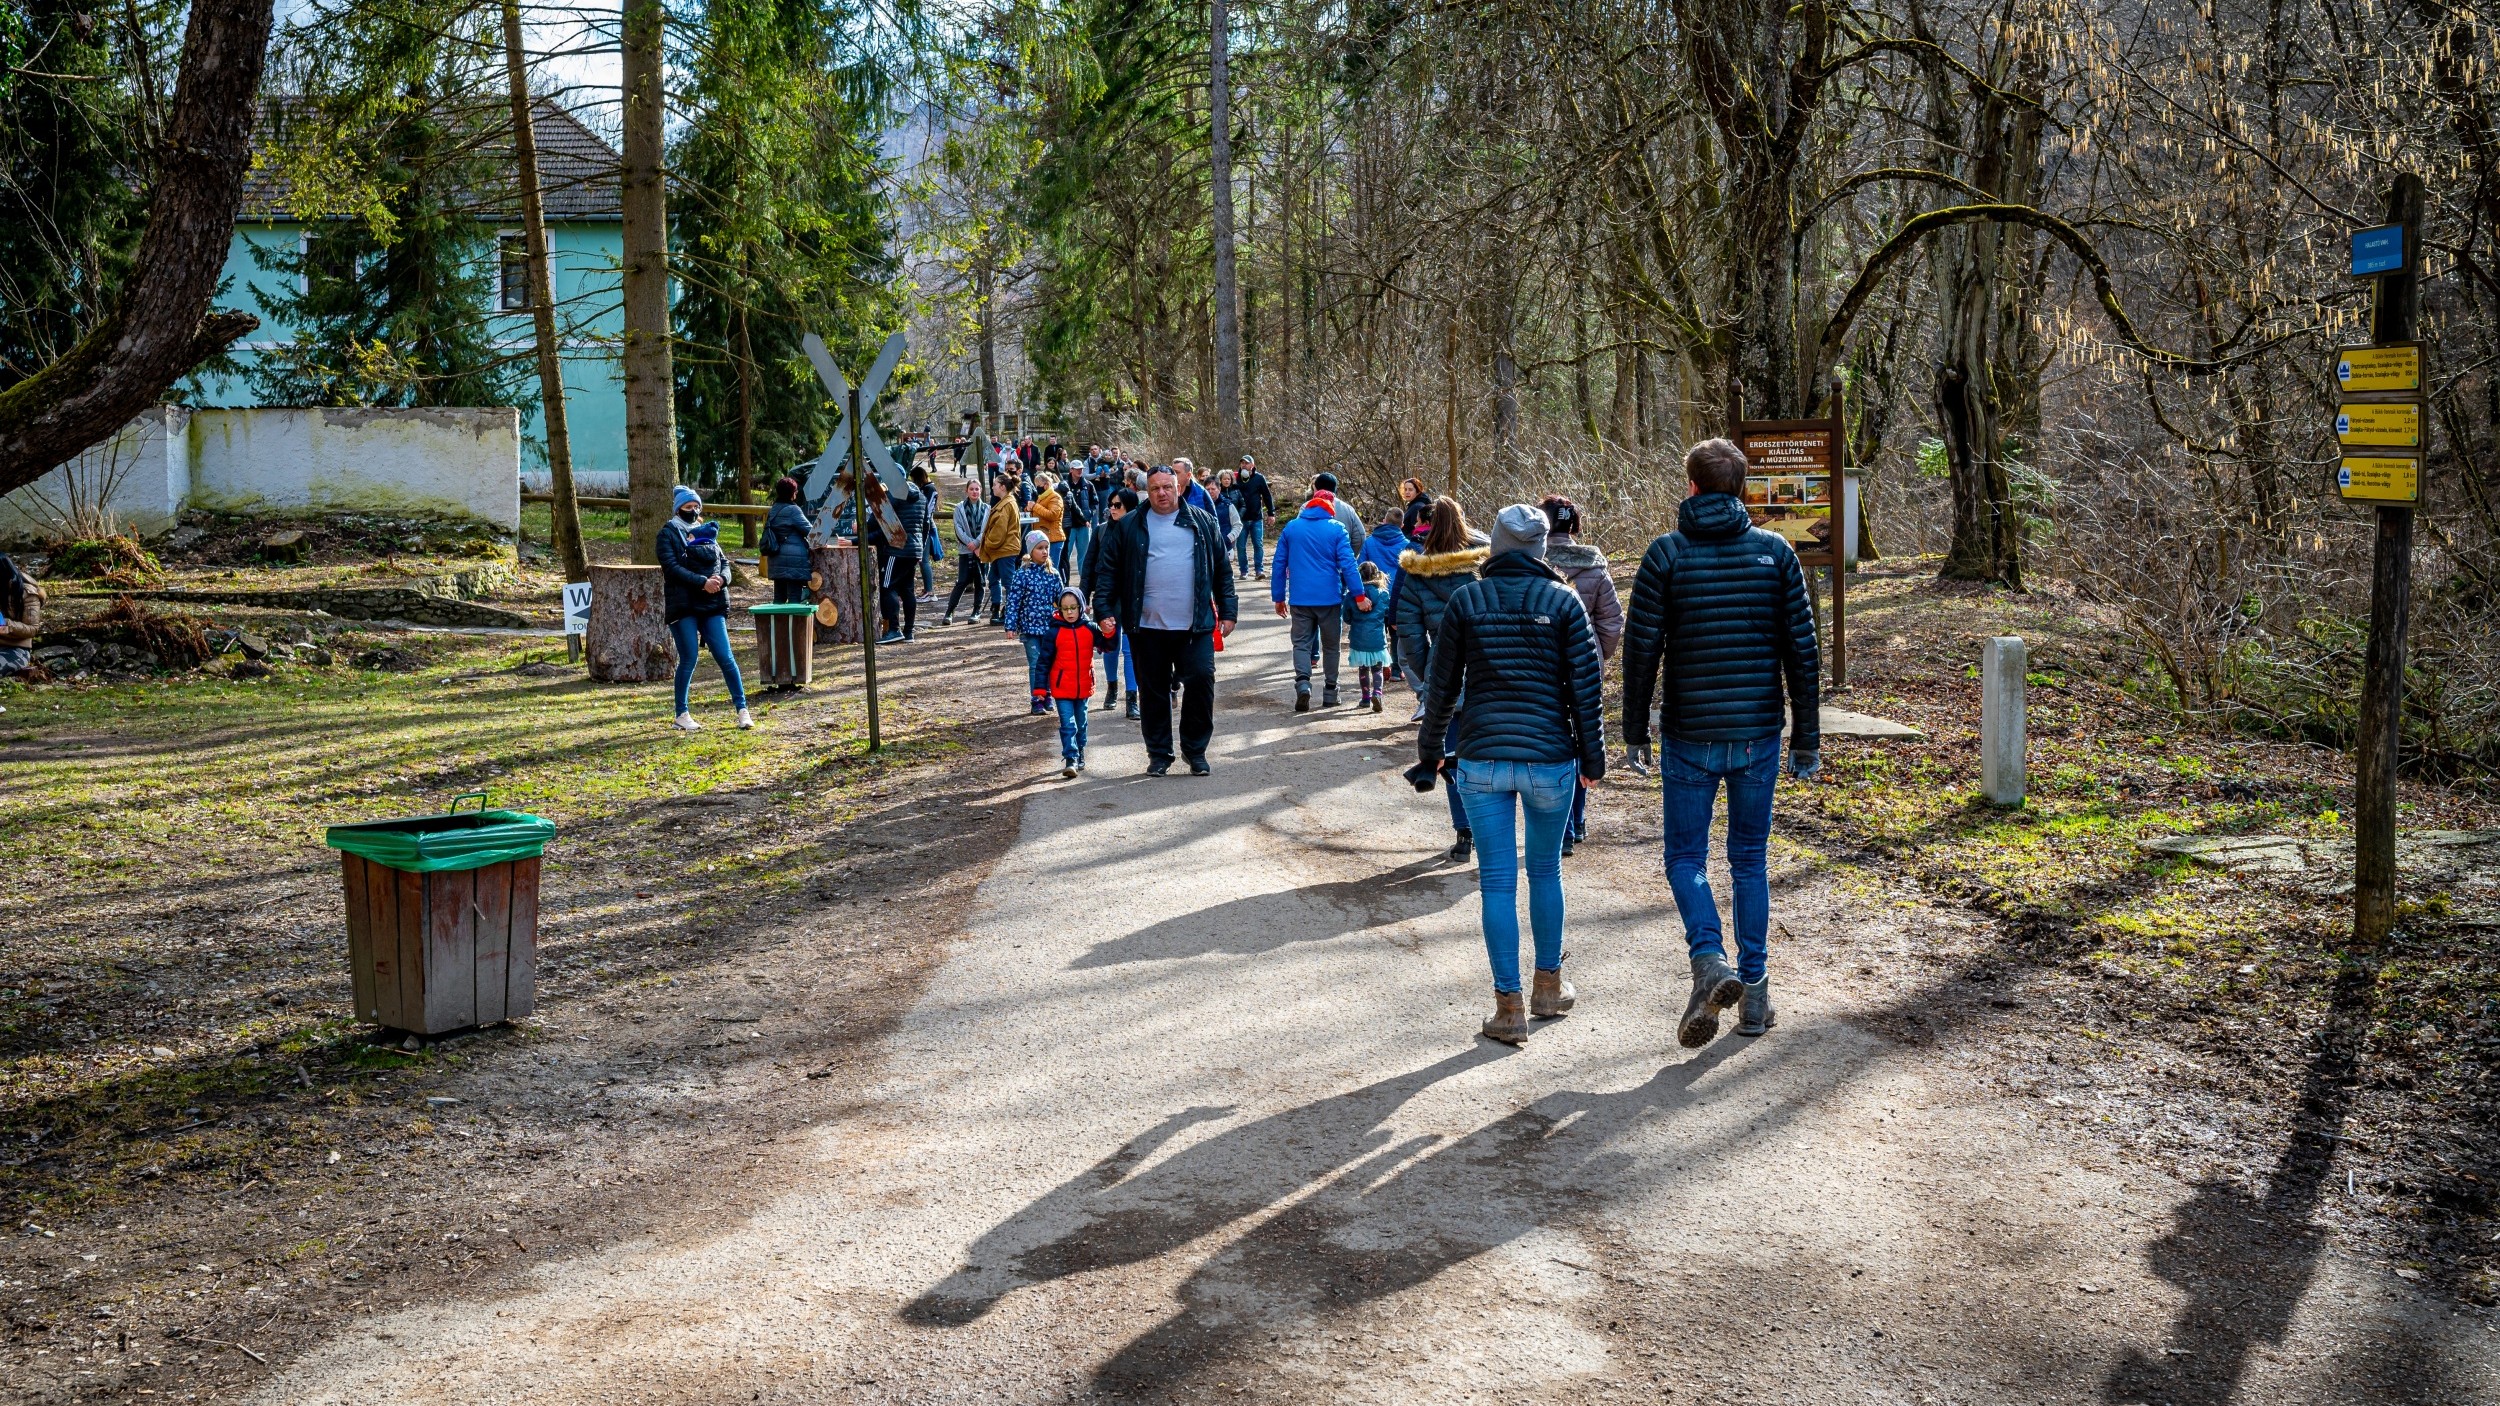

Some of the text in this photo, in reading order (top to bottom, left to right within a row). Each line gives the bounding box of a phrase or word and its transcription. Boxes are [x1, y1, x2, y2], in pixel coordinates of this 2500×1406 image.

[1749, 440, 1824, 448] ERDÉSZETTÖRTÉNETI
[1768, 447, 1804, 455] KIÁLLÍTÁS
[1766, 455, 1814, 463] MÚZEUMBAN
